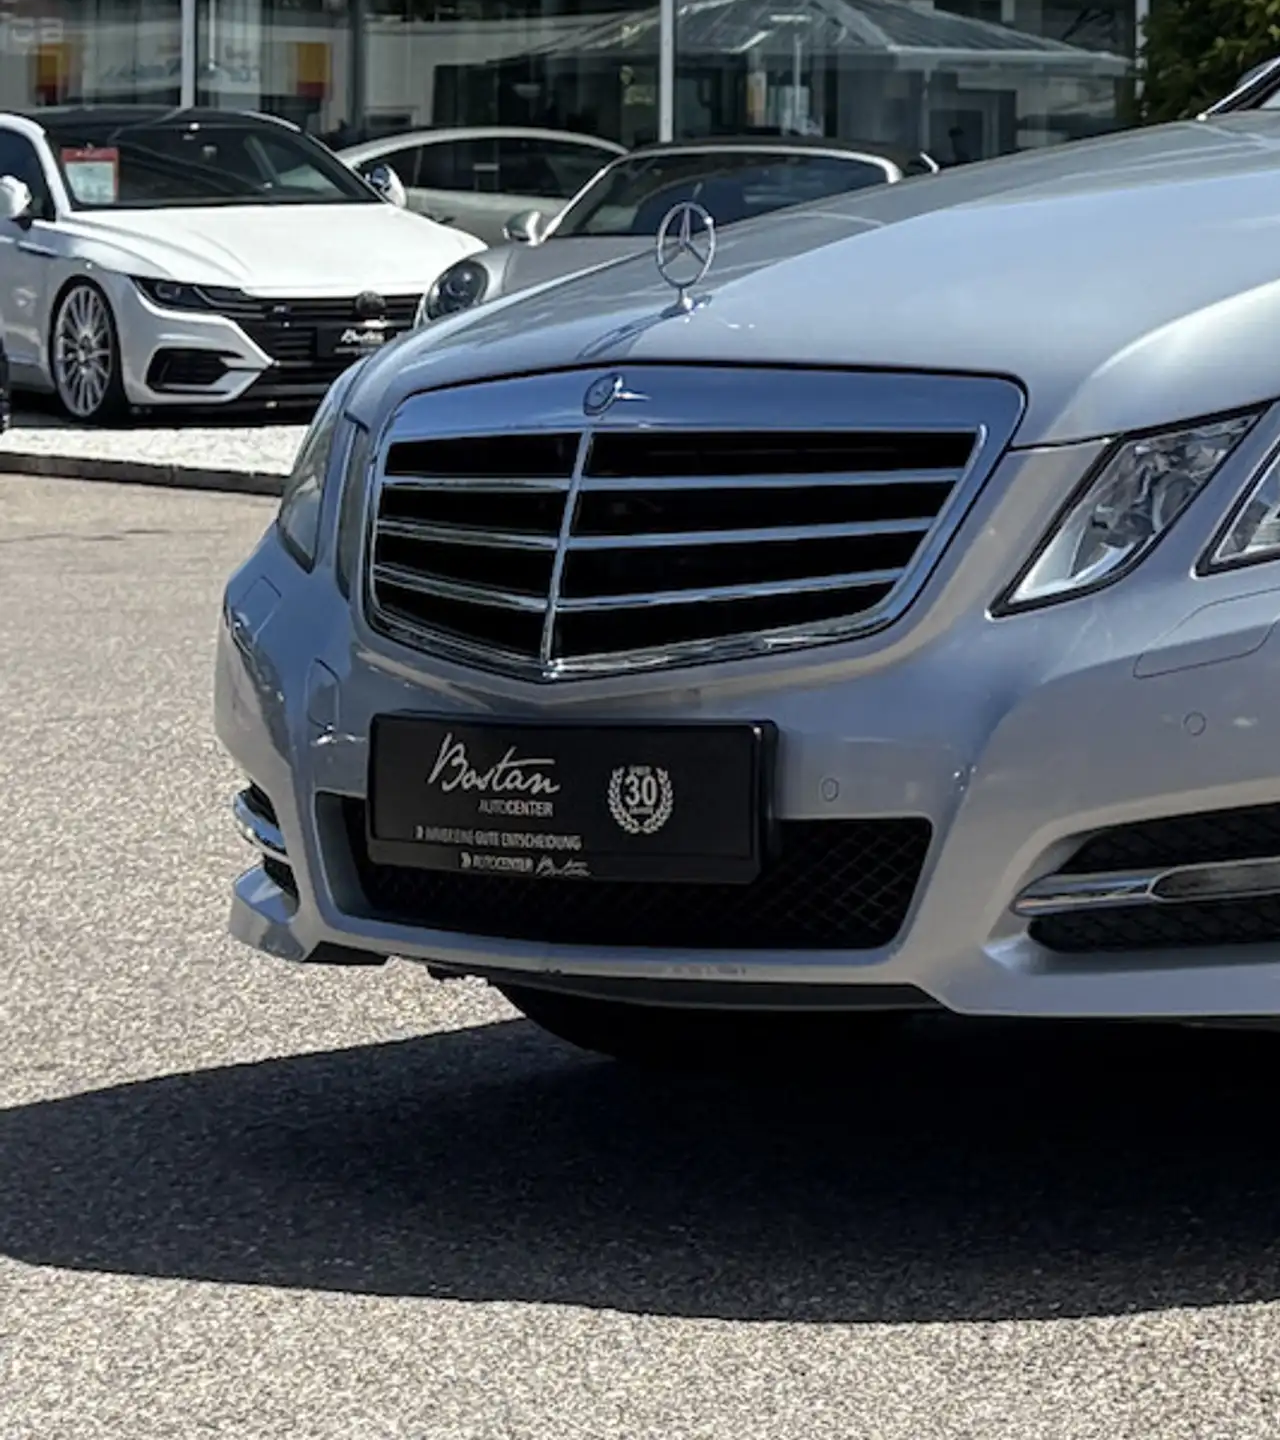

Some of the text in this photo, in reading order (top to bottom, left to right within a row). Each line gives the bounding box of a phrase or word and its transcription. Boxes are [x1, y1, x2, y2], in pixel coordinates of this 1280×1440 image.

[427, 732, 561, 795] Bostan
[624, 775, 658, 806] 30
[477, 799, 554, 818] AUTOCENTER
